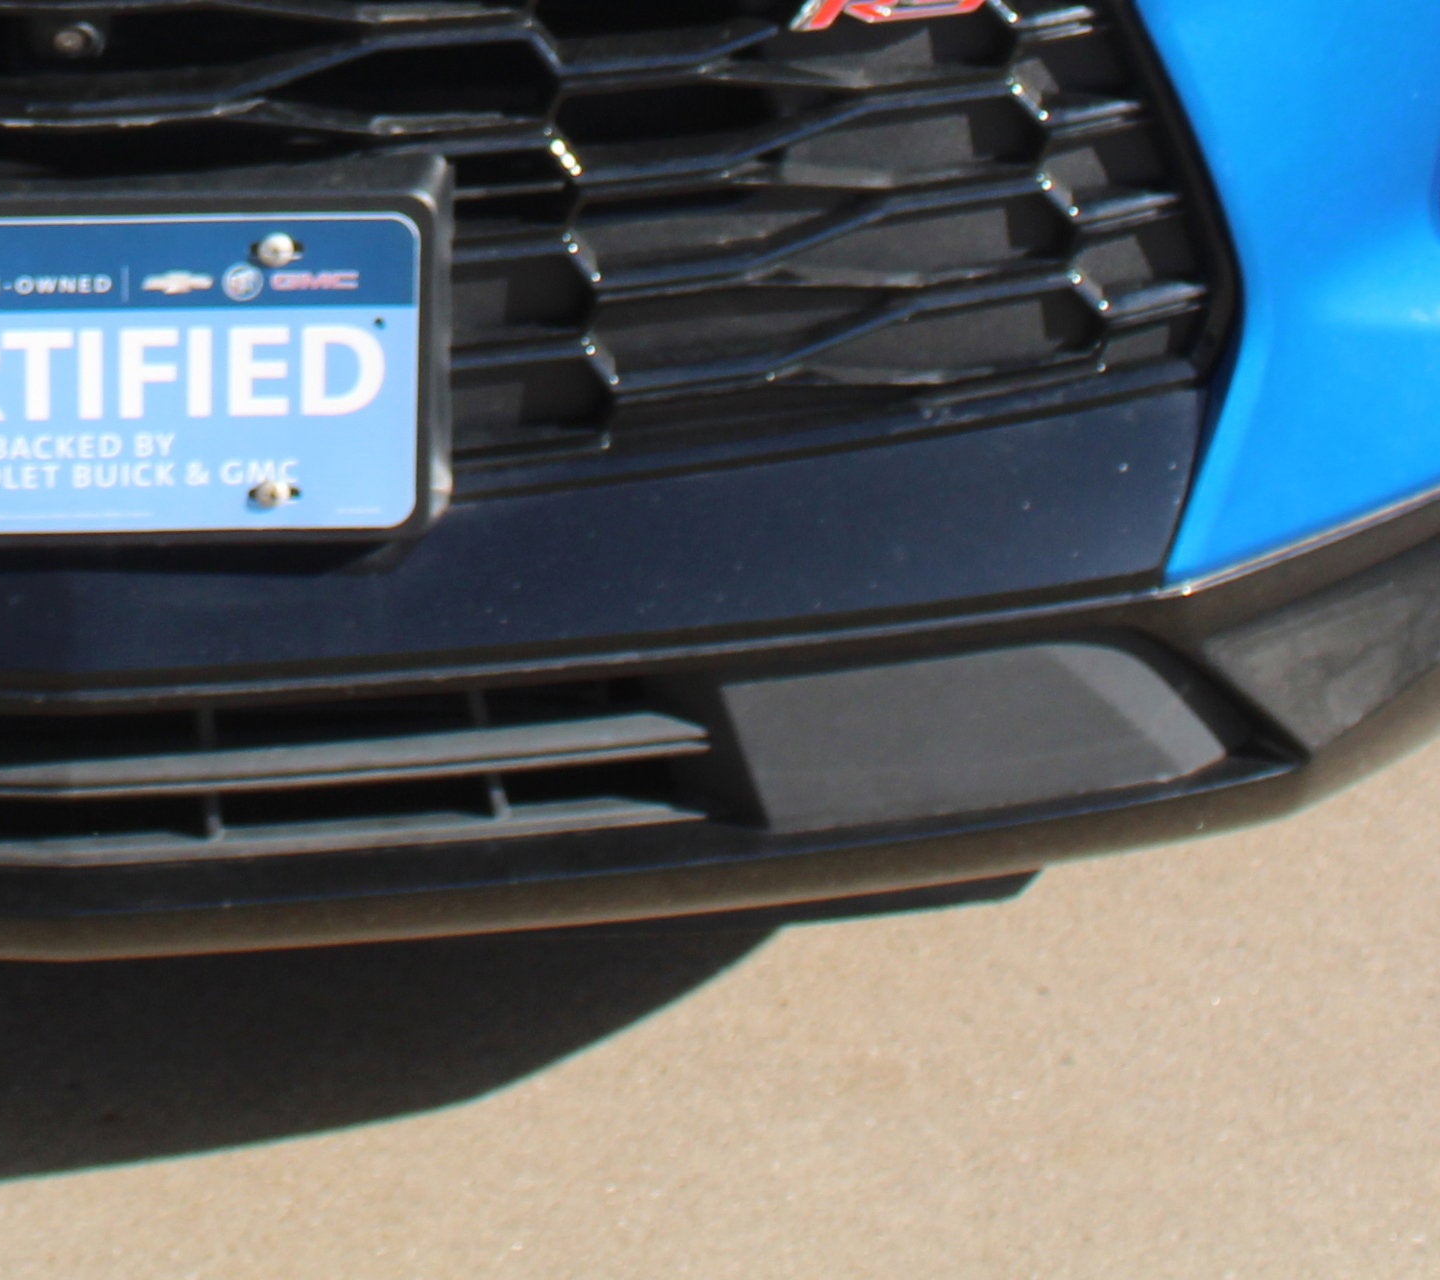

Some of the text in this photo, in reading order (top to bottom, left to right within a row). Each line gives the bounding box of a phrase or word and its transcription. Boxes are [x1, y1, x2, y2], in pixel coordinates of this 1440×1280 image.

[269, 270, 360, 290] GMC
[132, 432, 177, 460] BY
[72, 461, 176, 489] BUICK
[185, 461, 211, 487] &
[220, 458, 300, 486] GMC
